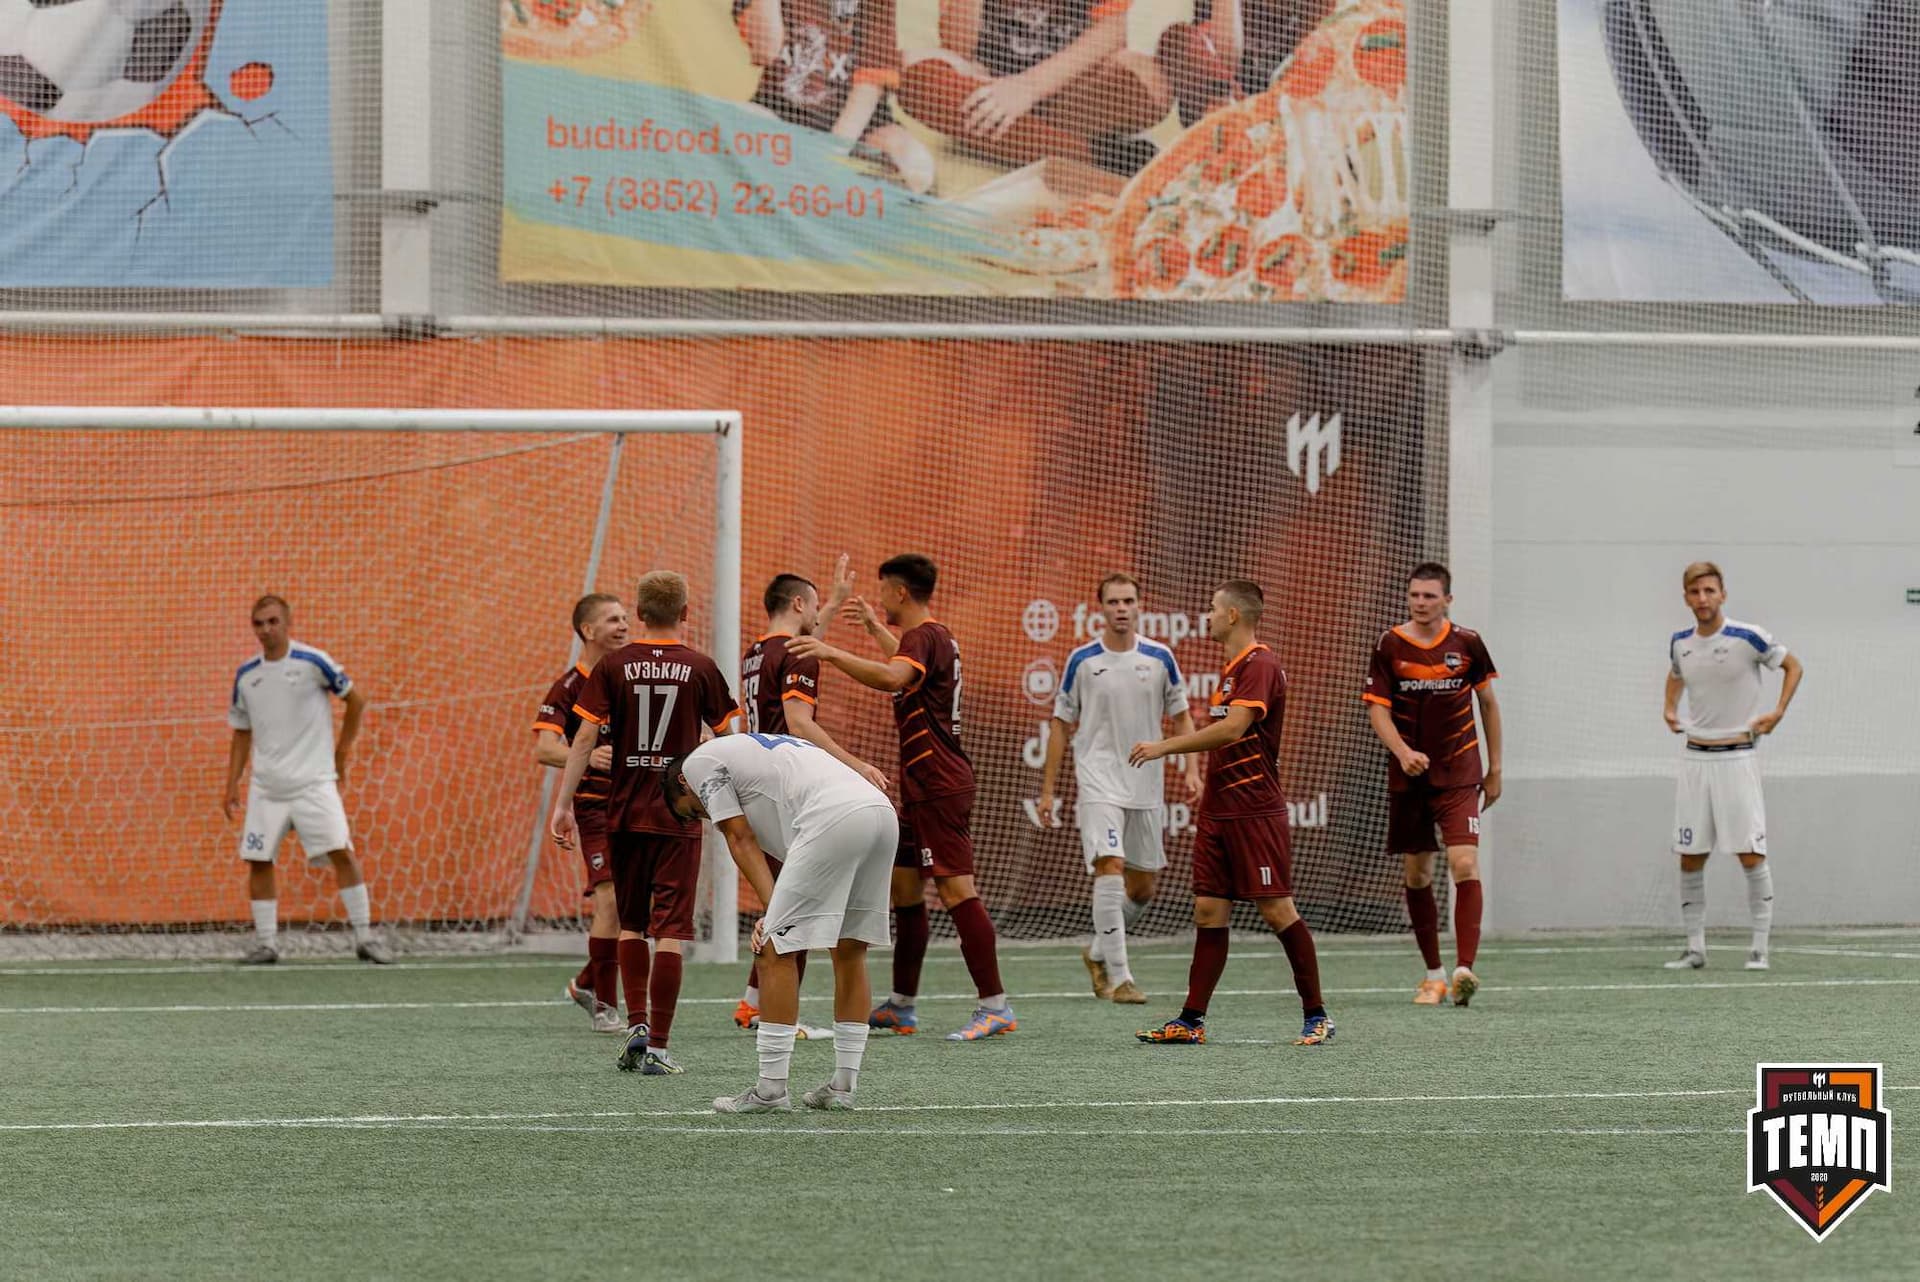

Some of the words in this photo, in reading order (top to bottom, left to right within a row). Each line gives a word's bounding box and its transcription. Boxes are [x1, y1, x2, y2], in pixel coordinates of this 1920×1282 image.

[547, 115, 792, 166] budufood.org
[548, 175, 592, 208] +7
[604, 175, 720, 219] (3852)
[732, 180, 884, 219] 22-66-01
[624, 661, 692, 683] КУЗЬКИН
[633, 684, 679, 751] 17
[247, 831, 265, 850] 96
[1107, 829, 1119, 848] 5
[1678, 827, 1693, 846] 19
[1259, 866, 1272, 886] 11
